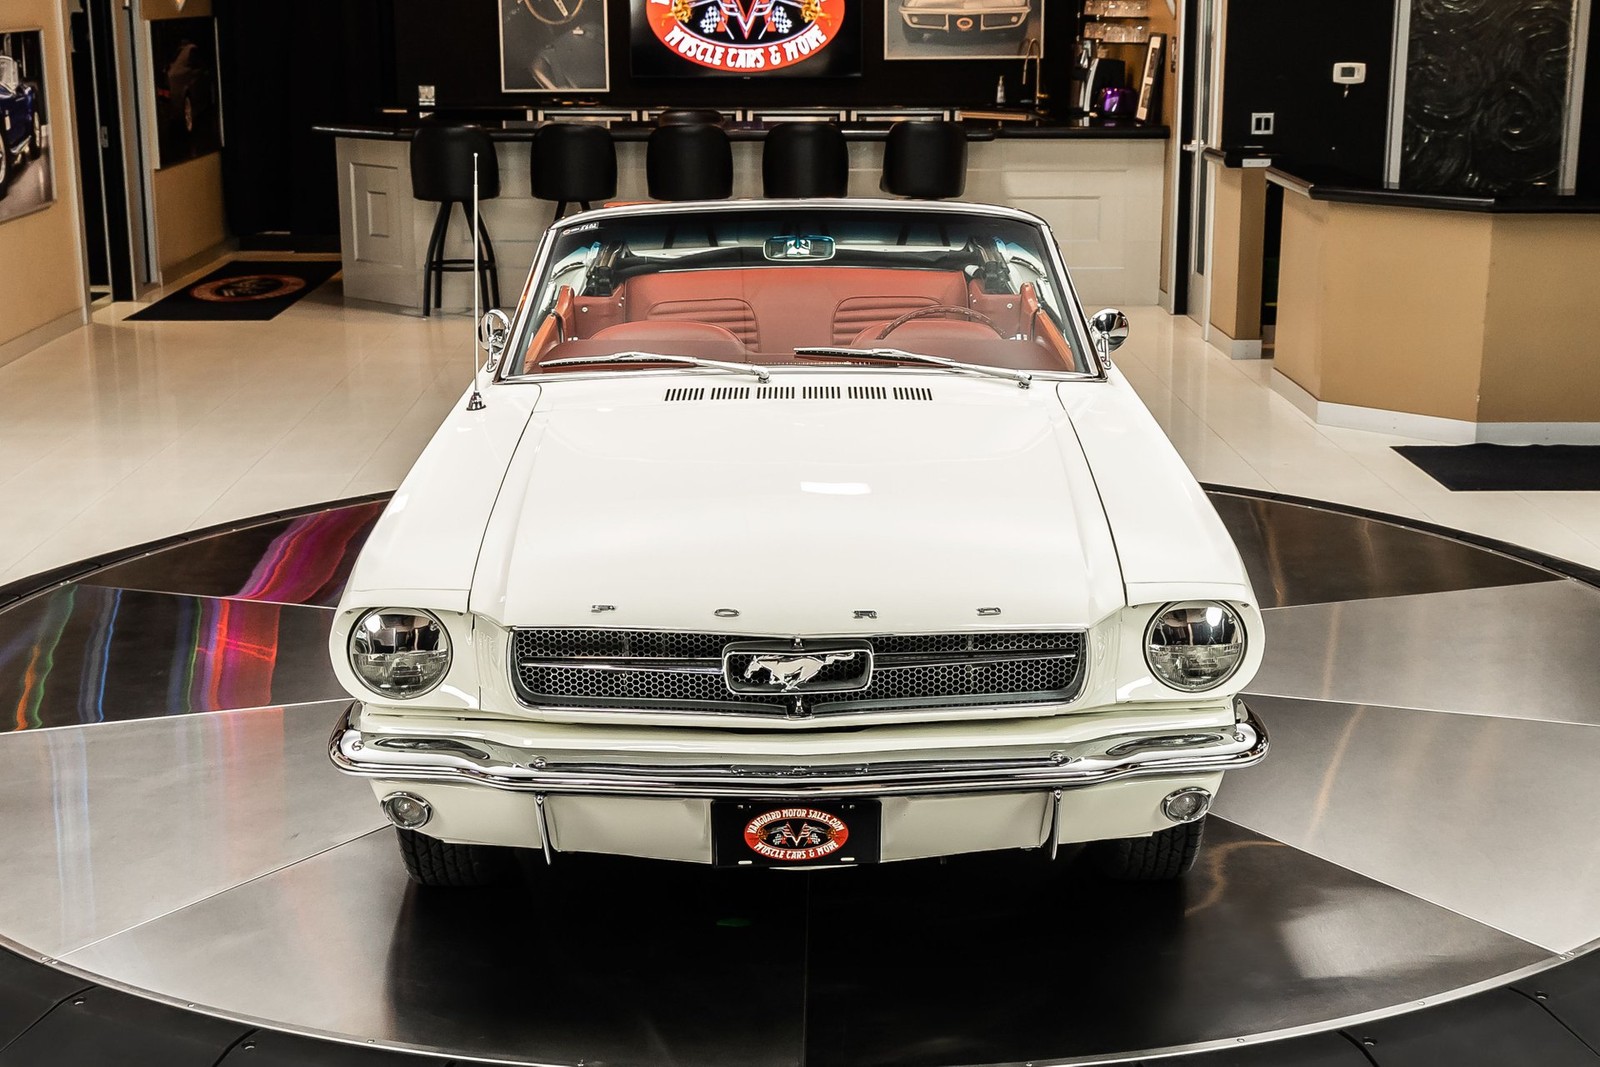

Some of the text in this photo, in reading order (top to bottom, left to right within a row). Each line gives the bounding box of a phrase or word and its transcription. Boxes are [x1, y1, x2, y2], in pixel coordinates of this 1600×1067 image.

[664, 24, 828, 69] MUSCLE CARS & MORE
[747, 808, 845, 834] VANGUARD MOTOR SALES.COM
[754, 840, 839, 860] MUSCLE CARS & MORE
